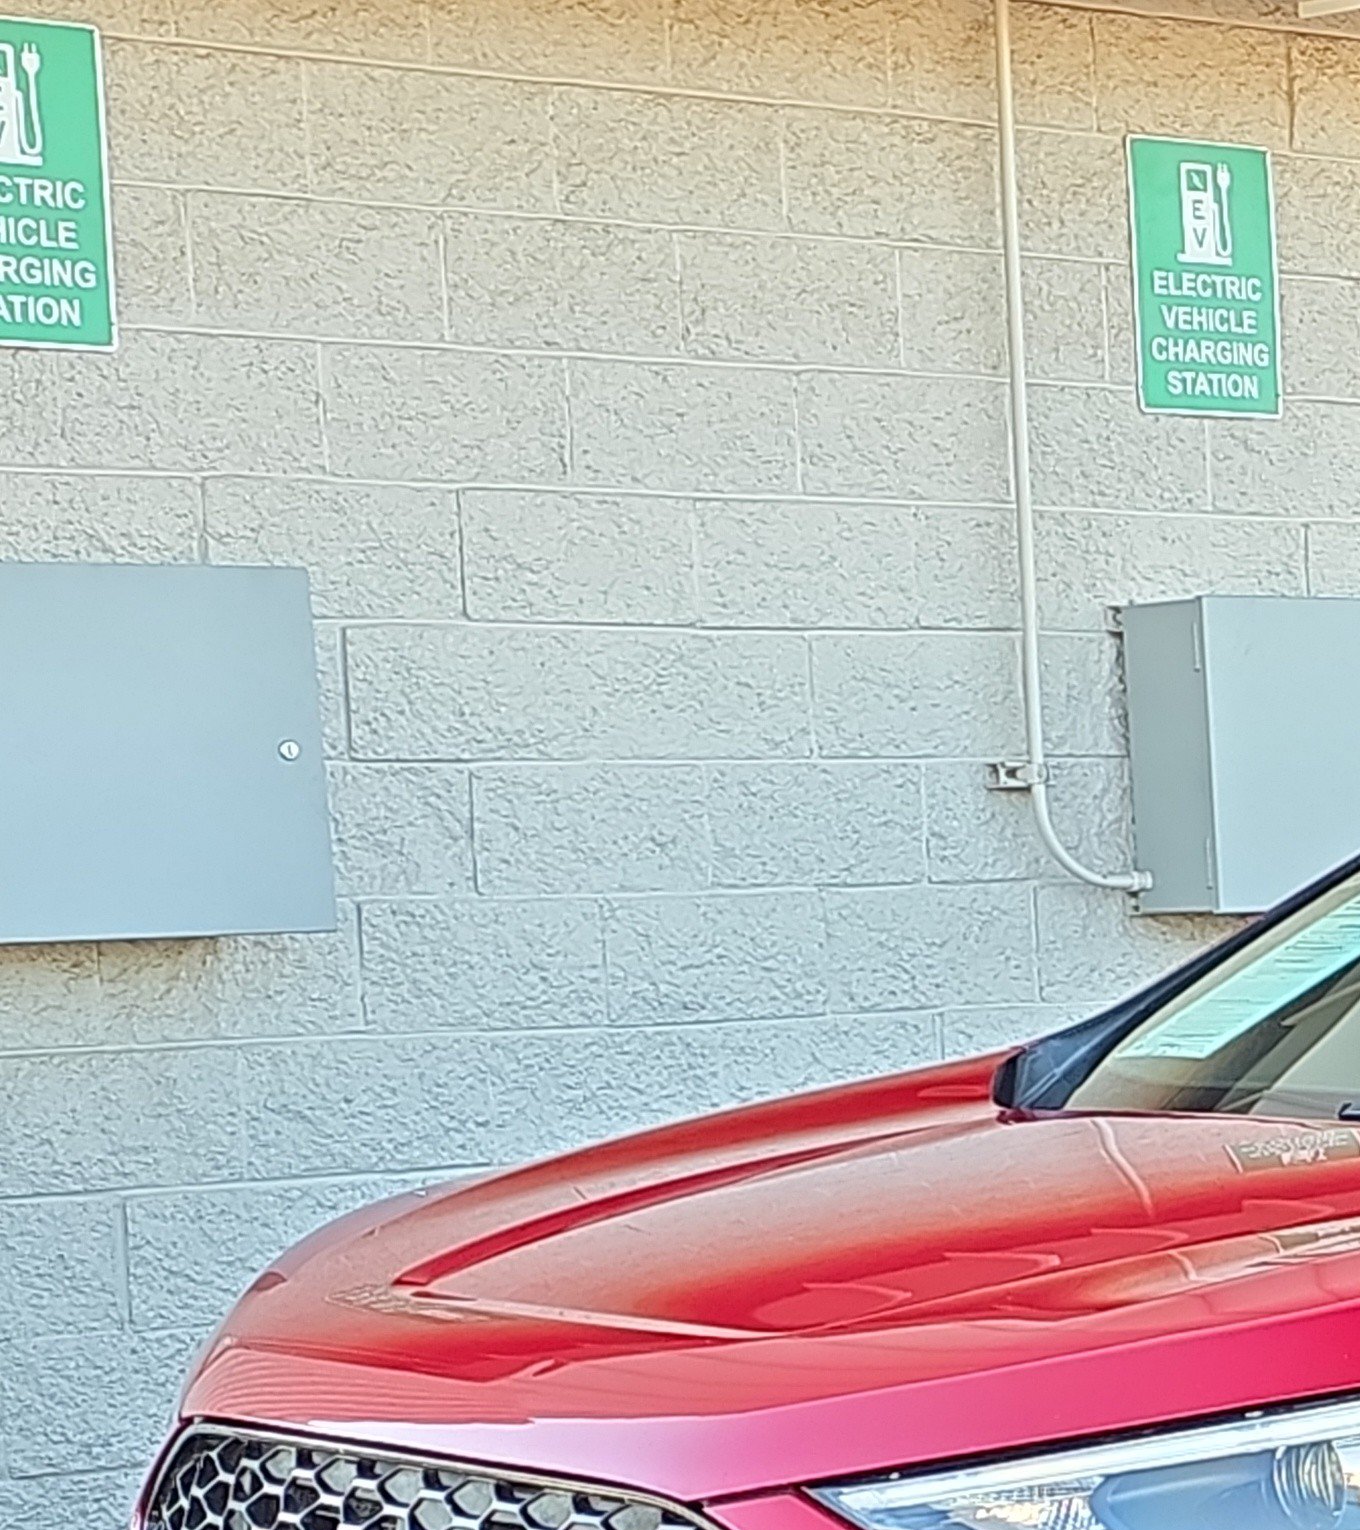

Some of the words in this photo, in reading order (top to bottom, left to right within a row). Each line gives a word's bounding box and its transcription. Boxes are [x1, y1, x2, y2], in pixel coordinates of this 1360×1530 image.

[0, 175, 86, 209] CTRIC
[0, 254, 97, 289] RGING
[1152, 270, 1263, 301] ELECTRIC
[1160, 304, 1258, 334] VEHICLE
[1151, 337, 1270, 367] CHARGING
[1166, 370, 1260, 399] STATION
